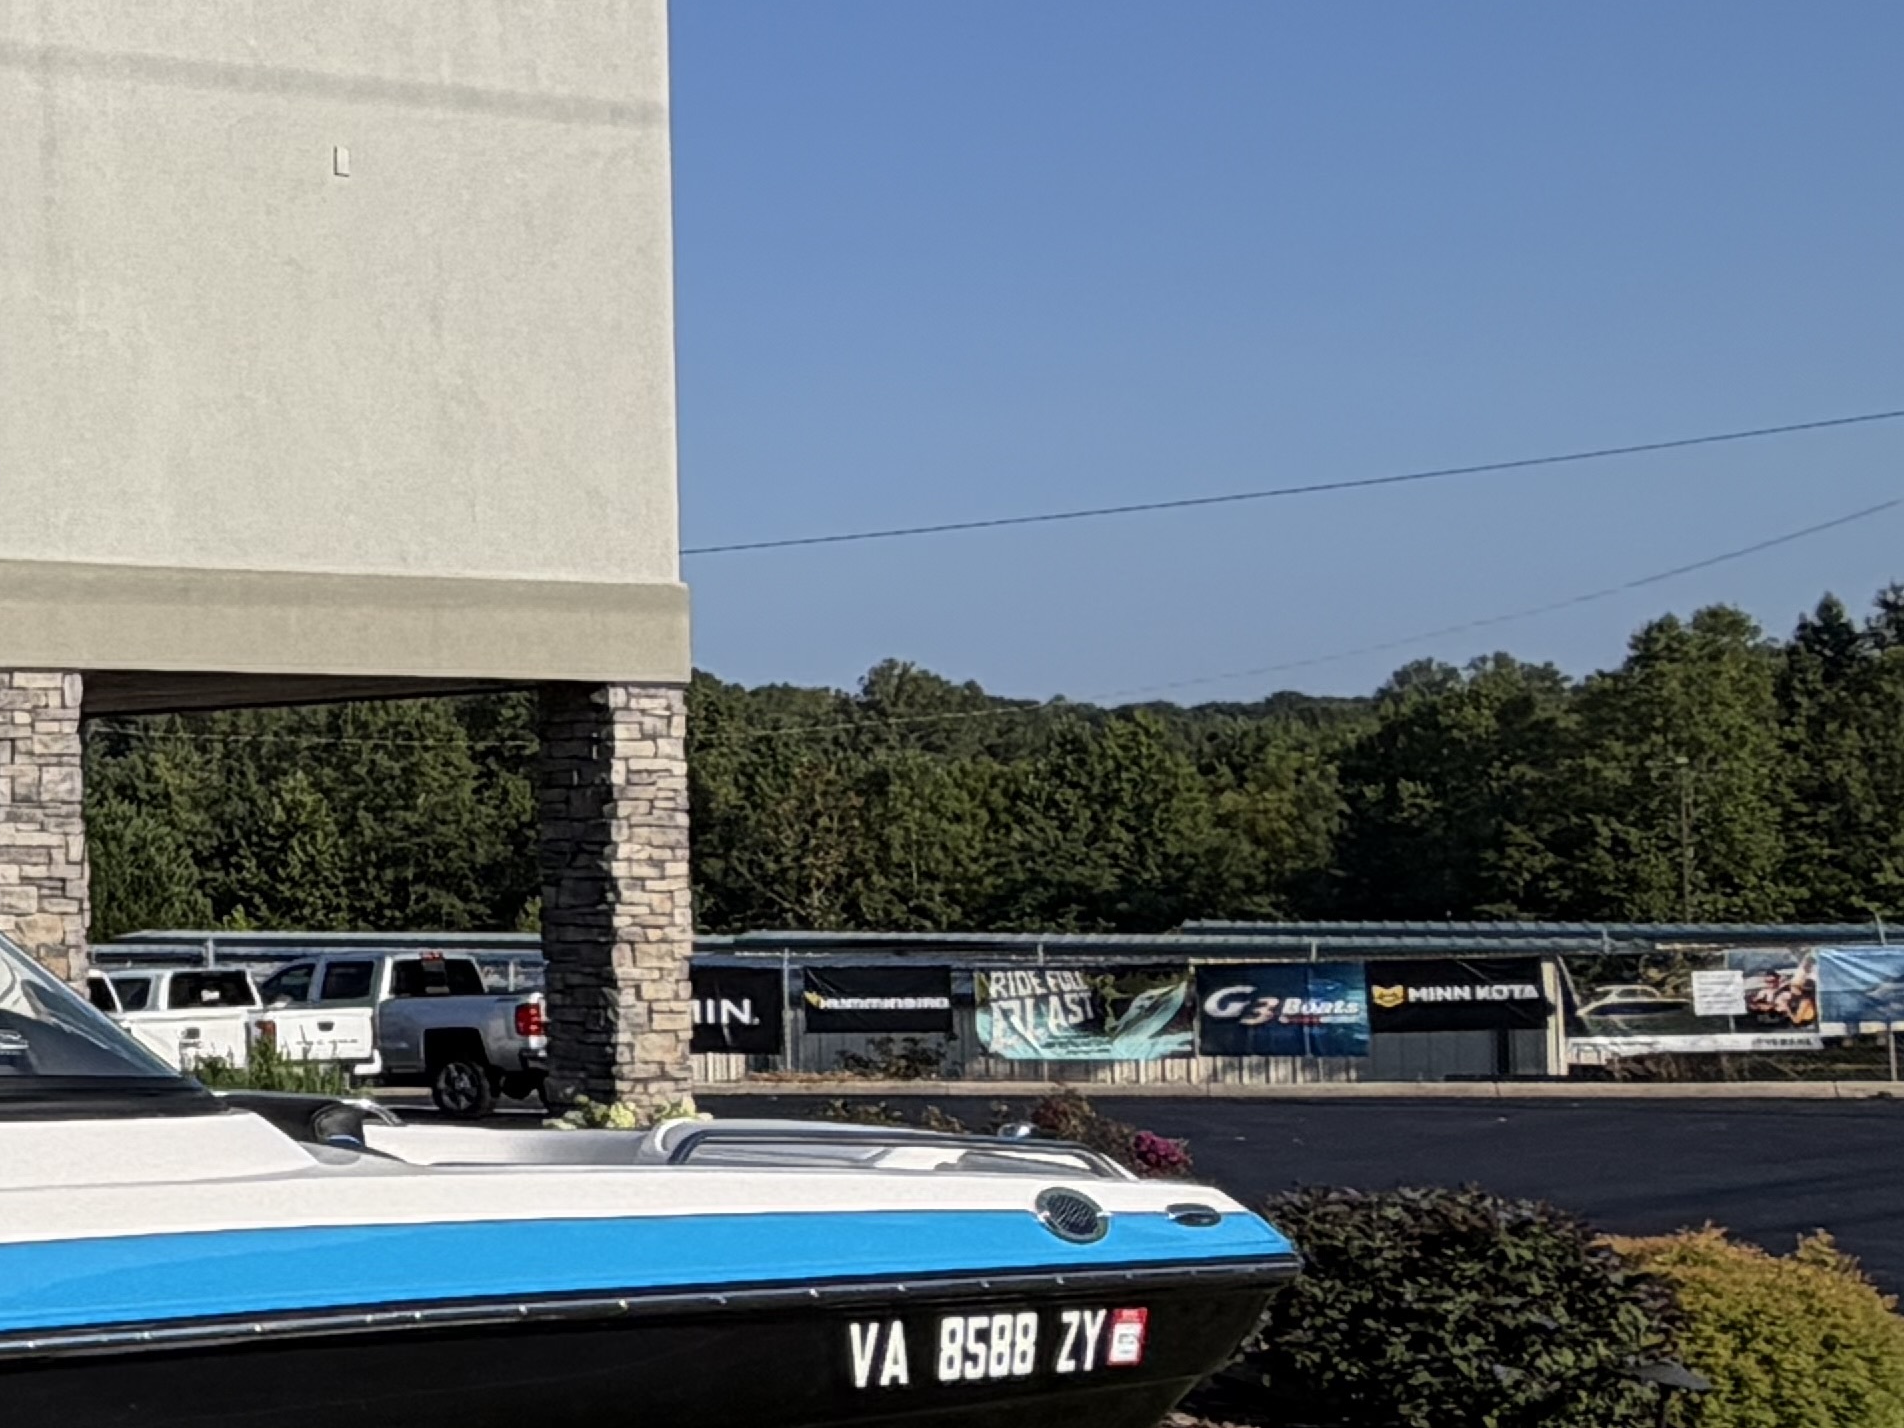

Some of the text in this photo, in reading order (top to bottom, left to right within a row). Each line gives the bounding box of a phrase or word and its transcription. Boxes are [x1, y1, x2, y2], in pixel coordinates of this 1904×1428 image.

[989, 970, 1048, 998] RIDE
[1408, 984, 1540, 1003] MINN KOTA
[1203, 984, 1360, 1025] G3 Boats
[849, 1319, 910, 1389] VA
[937, 1311, 1039, 1382] 8588
[1055, 1307, 1107, 1374] ZY
